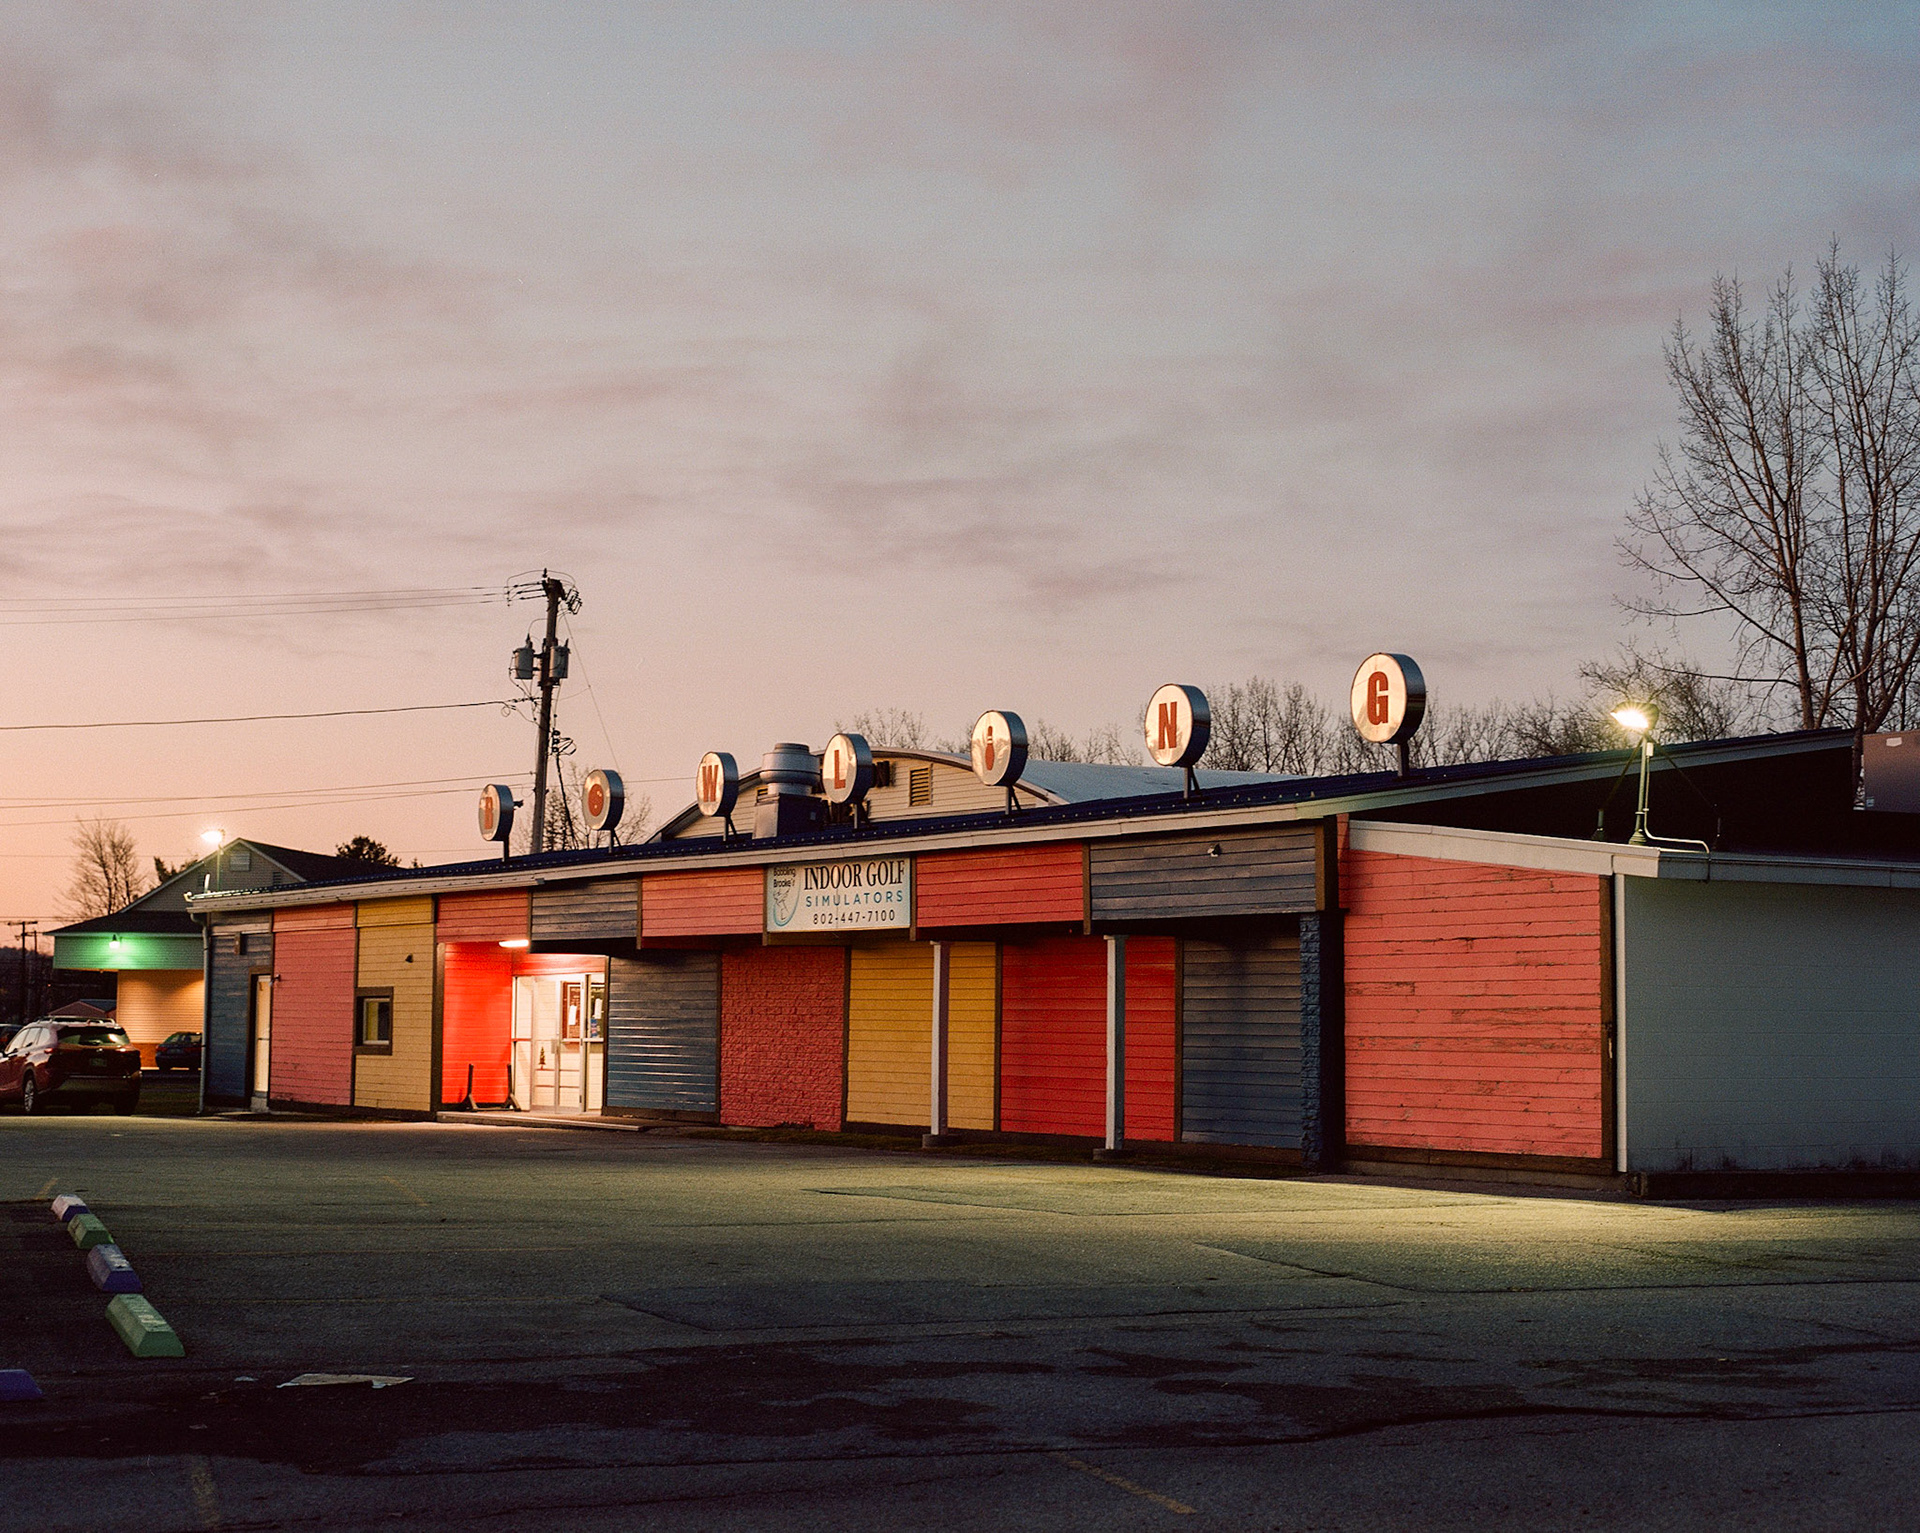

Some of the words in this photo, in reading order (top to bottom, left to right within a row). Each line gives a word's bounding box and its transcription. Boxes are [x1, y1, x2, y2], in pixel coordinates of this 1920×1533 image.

[804, 863, 862, 890] INDOOR
[866, 860, 905, 887] GOLF
[805, 890, 903, 907] SIMULATORS
[812, 909, 895, 925] 802-447-7100
